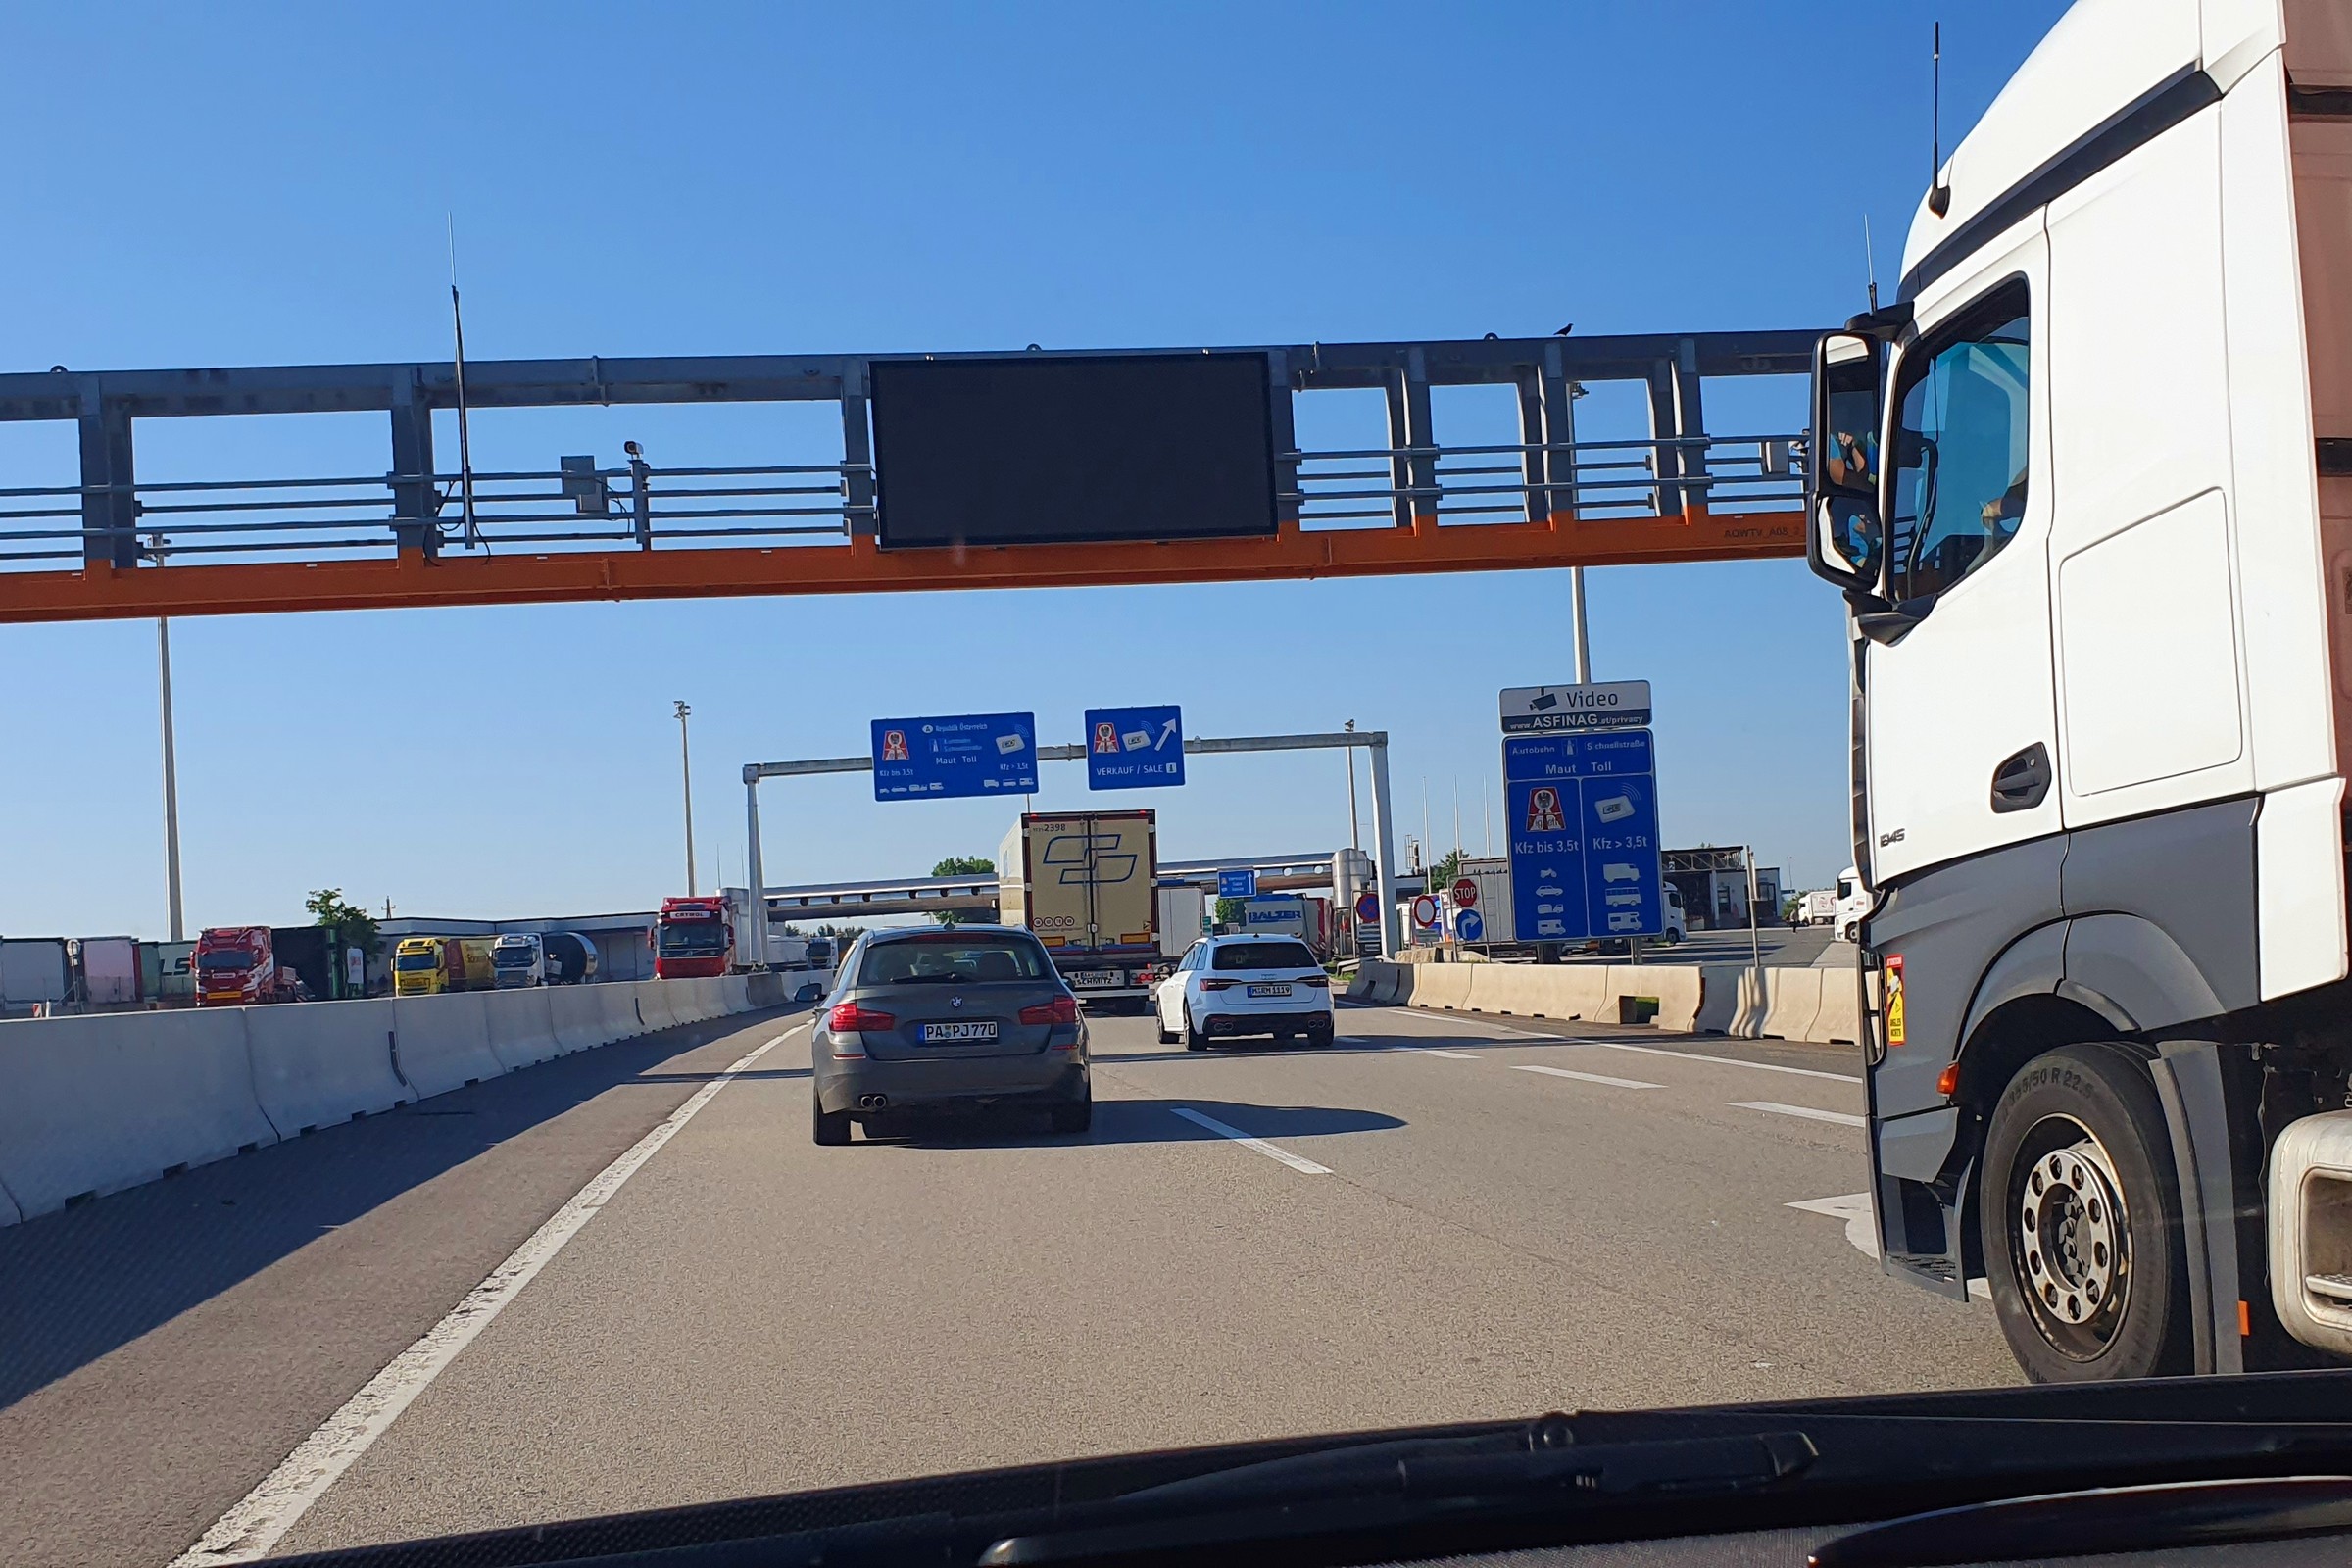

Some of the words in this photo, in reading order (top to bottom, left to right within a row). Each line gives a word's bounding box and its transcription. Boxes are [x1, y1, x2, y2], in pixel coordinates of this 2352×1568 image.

[1566, 690, 1619, 708] Video
[1512, 745, 1555, 756] Autobahn
[936, 756, 956, 765] Maut
[961, 755, 977, 763] Toll
[1096, 765, 1134, 776] VERKAUF
[1143, 764, 1164, 774] SALE
[1545, 763, 1577, 775] Maut
[1591, 760, 1612, 772] Toll
[1044, 823, 1066, 832] 2398
[1515, 841, 1534, 855] Kfz
[1536, 840, 1554, 854] bis
[1592, 837, 1612, 850] Kfz
[1614, 839, 1622, 848] >
[1625, 835, 1647, 850] 3,5t
[1454, 887, 1476, 900] STOP
[1249, 910, 1301, 922] BALZER
[925, 1025, 944, 1039] PA
[2051, 1067, 2061, 1084] R
